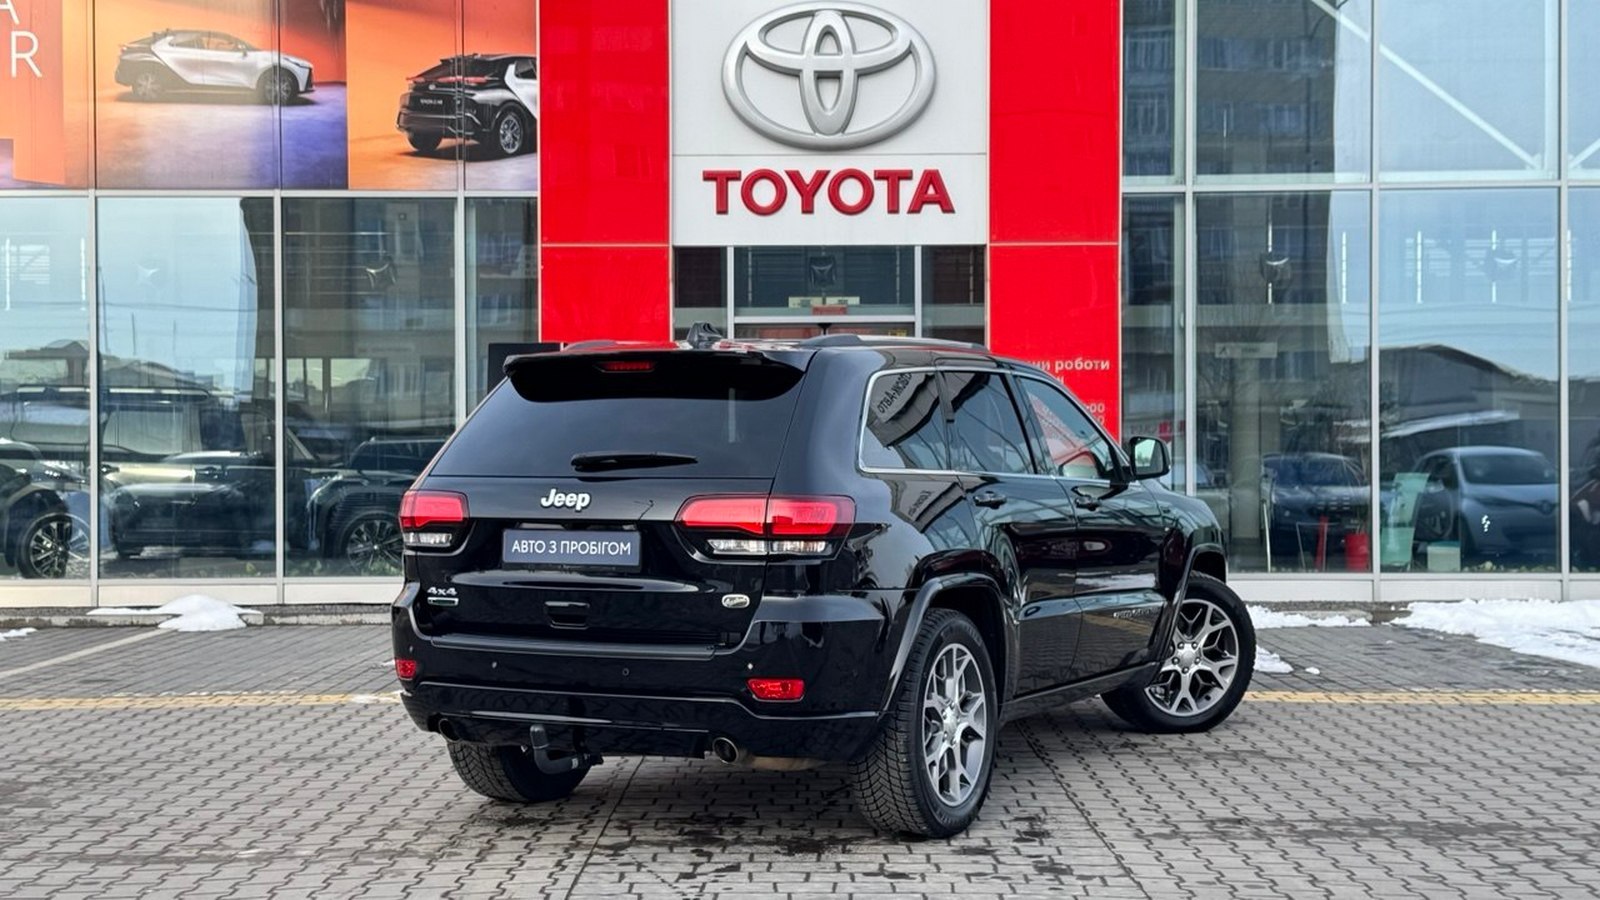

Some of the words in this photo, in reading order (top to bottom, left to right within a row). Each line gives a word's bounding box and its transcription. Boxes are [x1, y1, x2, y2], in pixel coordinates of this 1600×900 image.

[702, 168, 956, 216] TOYOTA
[1055, 357, 1110, 374] роботи
[540, 488, 591, 512] Jeep
[511, 539, 546, 554] АВТО
[548, 540, 558, 554] З
[560, 540, 631, 556] ПРОБІГОМ
